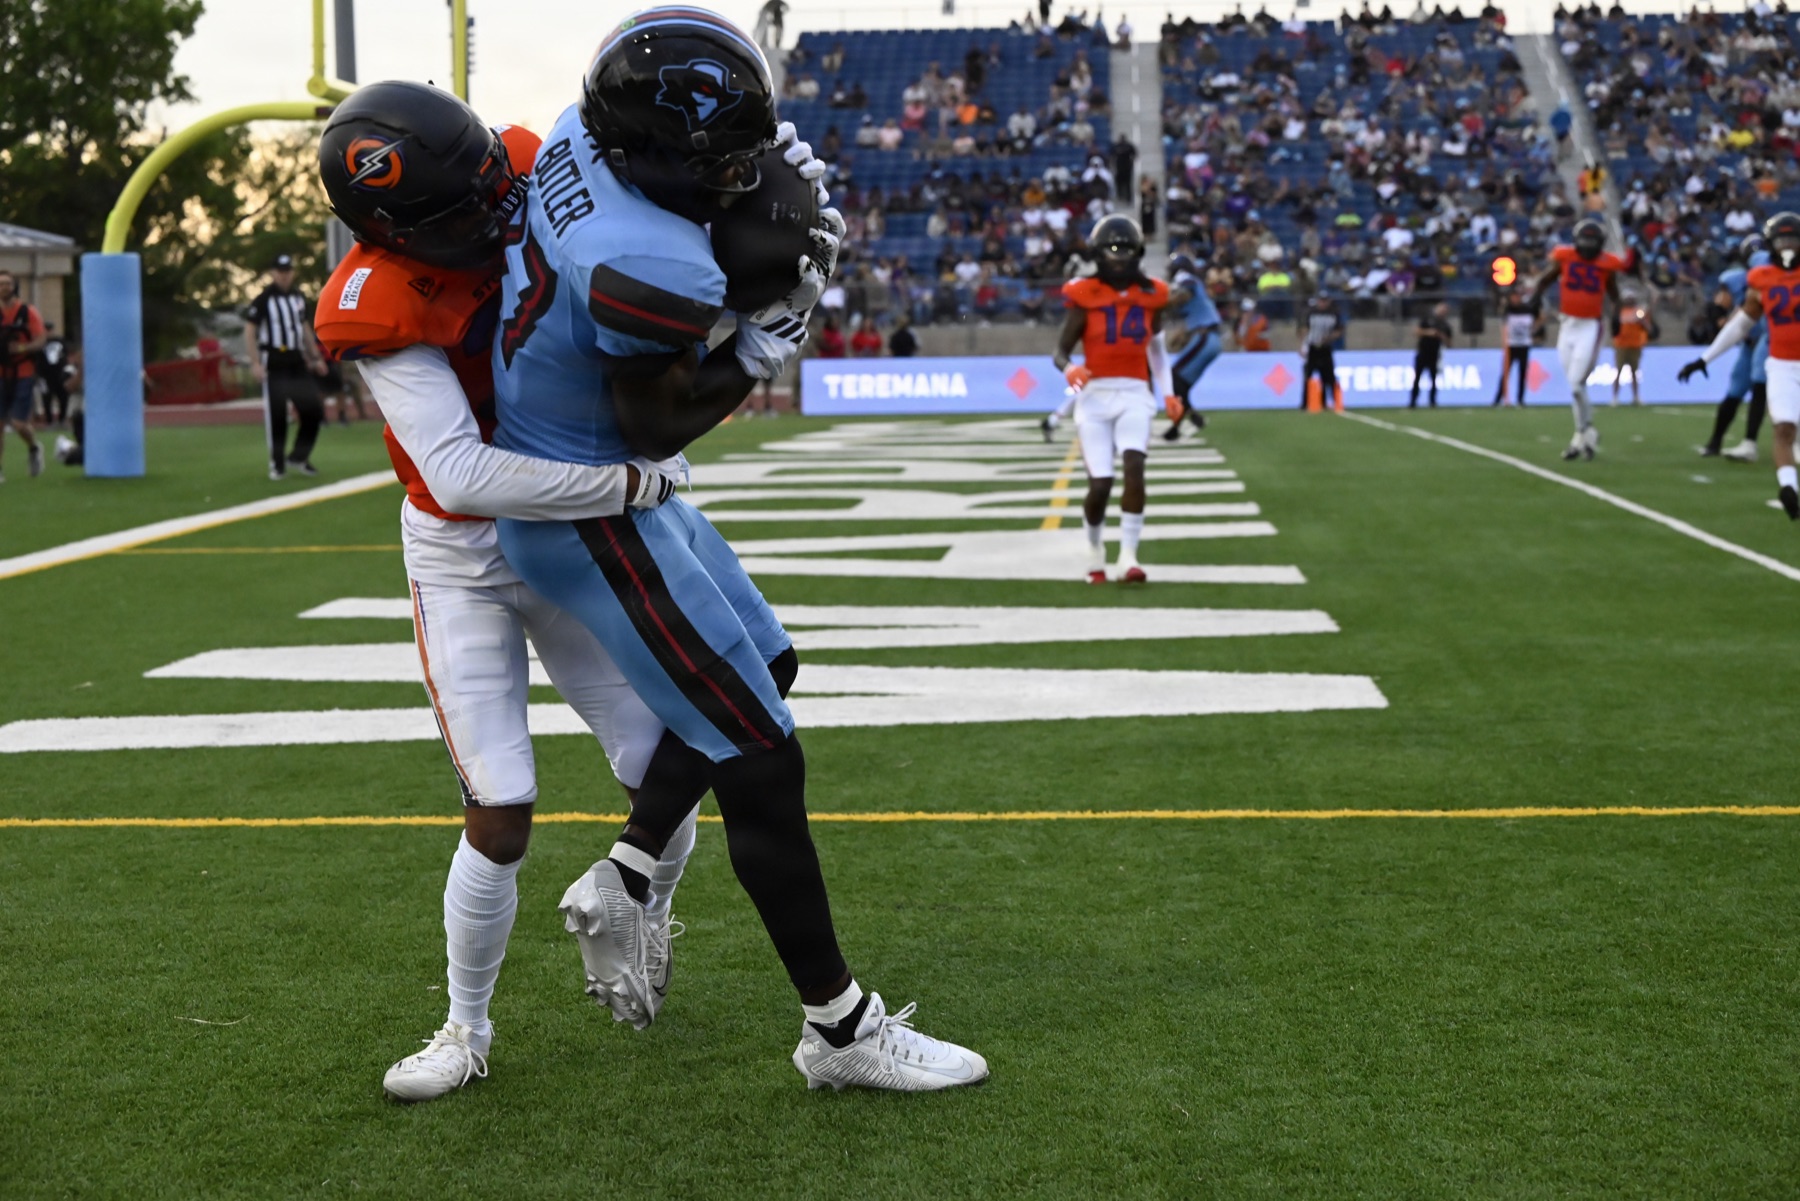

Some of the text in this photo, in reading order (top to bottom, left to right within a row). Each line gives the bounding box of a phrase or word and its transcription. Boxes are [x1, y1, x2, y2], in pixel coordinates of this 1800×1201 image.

[534, 136, 596, 240] BUTLER
[1492, 256, 1517, 286] 3
[1566, 261, 1601, 293] 55
[1099, 304, 1148, 345] 14
[822, 372, 969, 400] TEREMANA
[802, 1040, 821, 1057] NIKE
